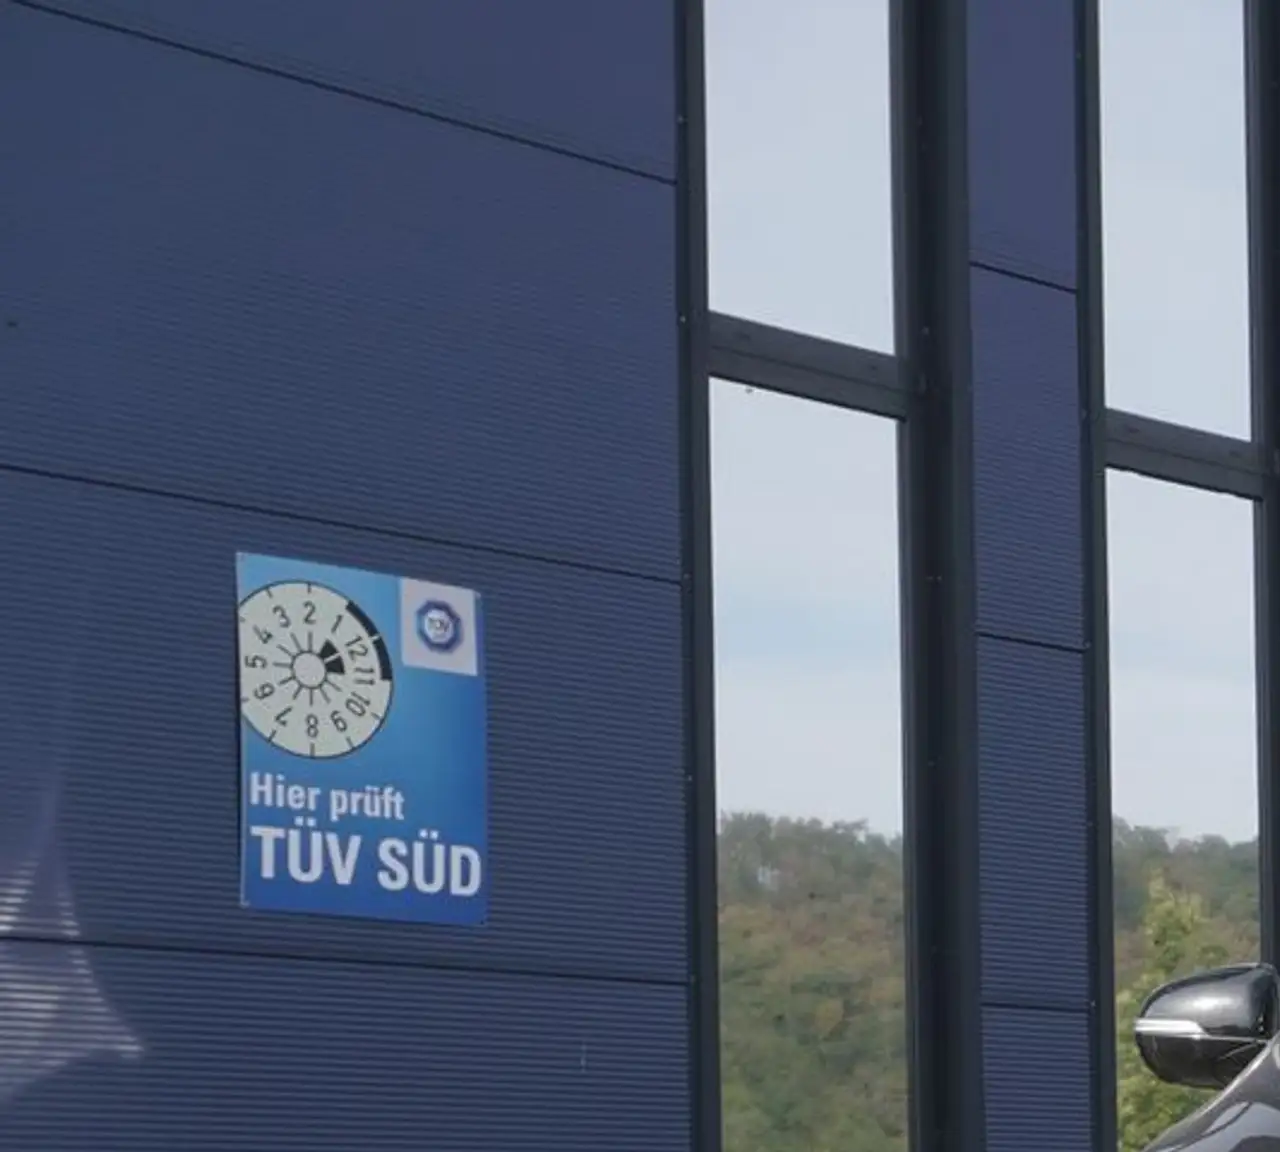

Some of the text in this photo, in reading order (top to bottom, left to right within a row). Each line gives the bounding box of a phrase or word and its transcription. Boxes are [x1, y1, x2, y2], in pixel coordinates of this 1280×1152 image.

[272, 606, 291, 628] 3
[303, 601, 317, 624] 2
[331, 614, 343, 633] 1
[253, 625, 273, 644] 4
[345, 635, 369, 660] 12
[245, 655, 267, 669] 5
[354, 667, 375, 686] 11
[345, 692, 371, 717] 10
[306, 714, 319, 738] 8
[250, 771, 405, 822] Hier prüft
[250, 816, 481, 896] TÜV SÜD
